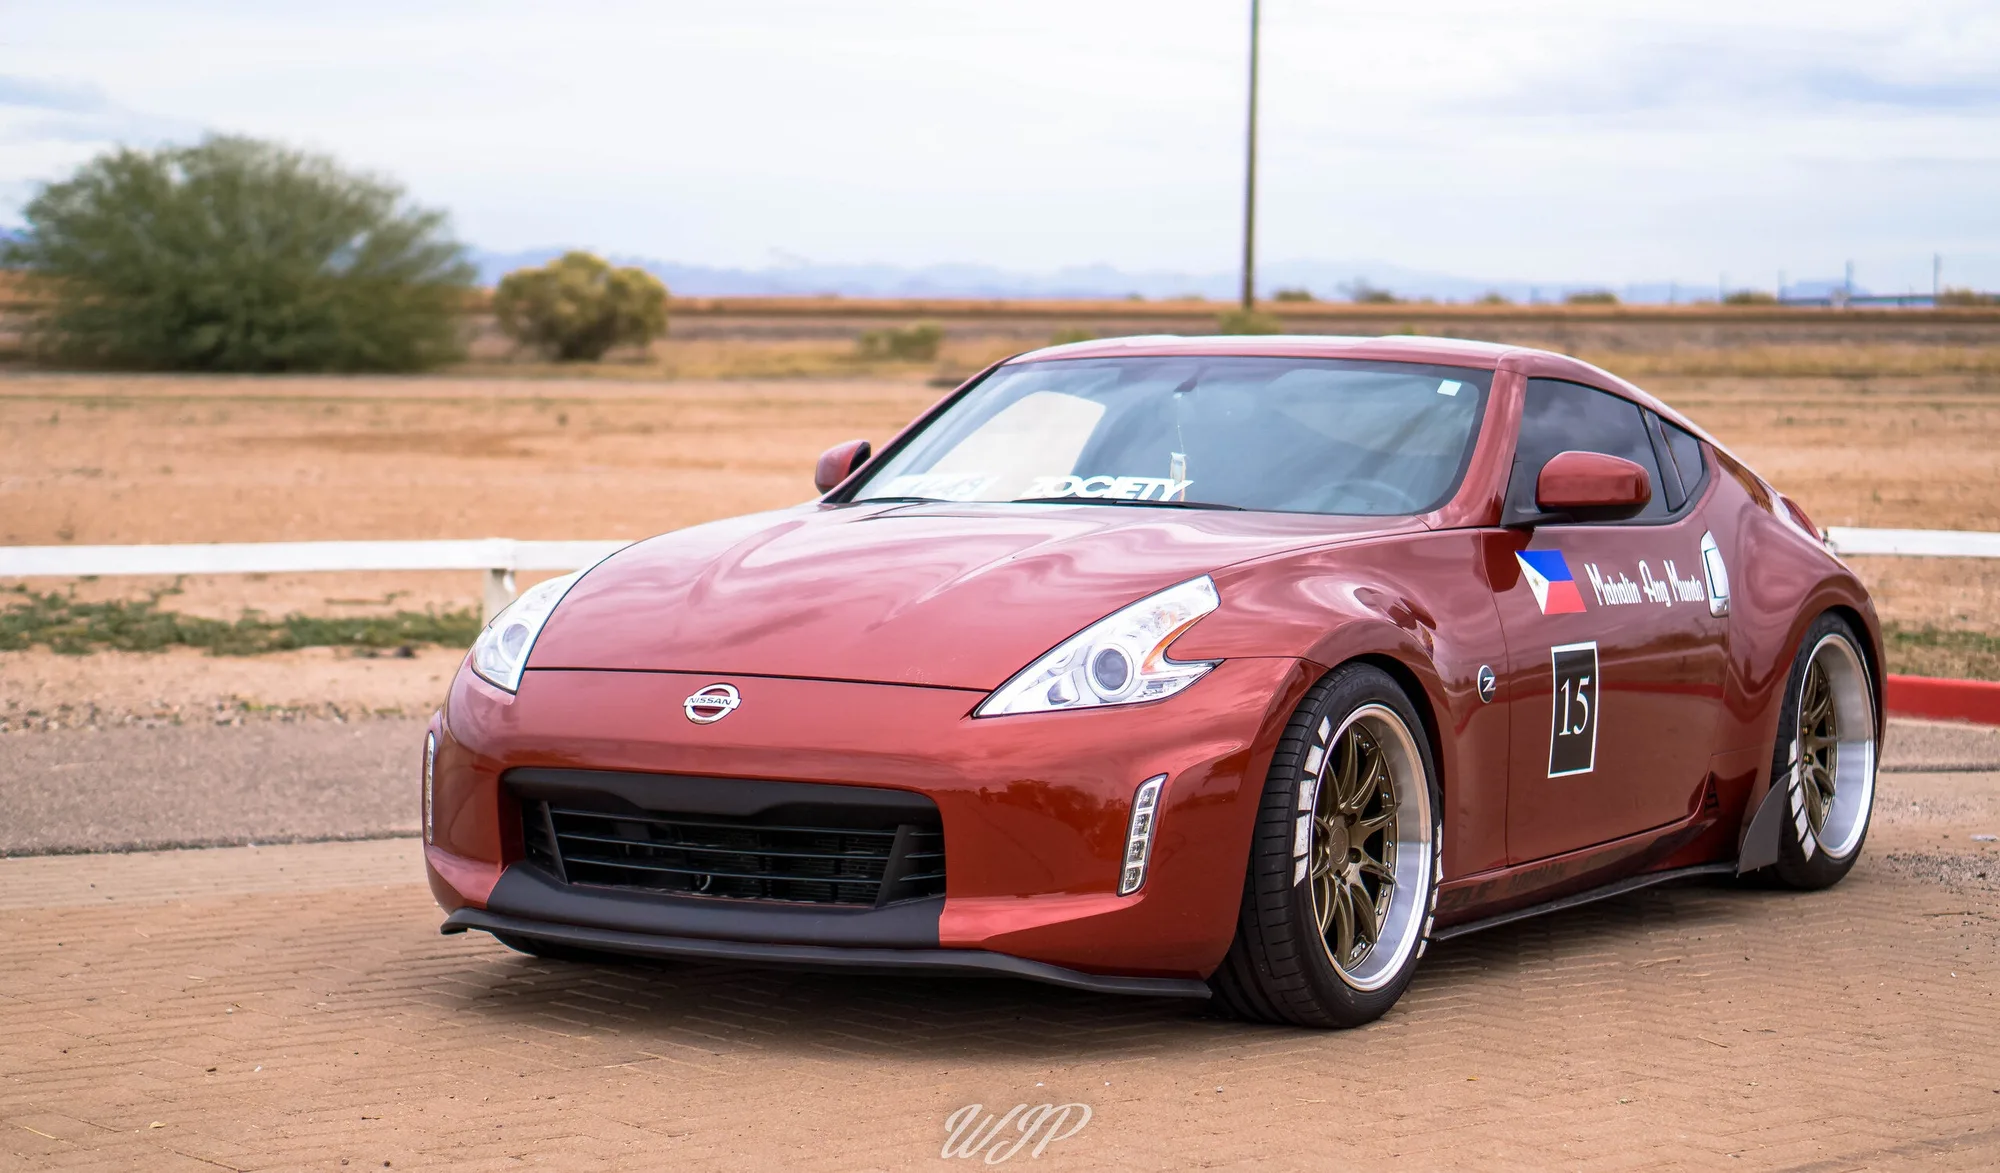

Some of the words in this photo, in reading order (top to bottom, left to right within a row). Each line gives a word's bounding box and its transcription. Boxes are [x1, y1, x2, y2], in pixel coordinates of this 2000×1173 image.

[1584, 562, 1642, 606] Mahalin
[1638, 559, 1671, 607] Ang
[1663, 559, 1705, 602] Mundo
[1482, 676, 1497, 693] Z
[688, 697, 732, 706] NISSAN
[1558, 675, 1590, 736] 15
